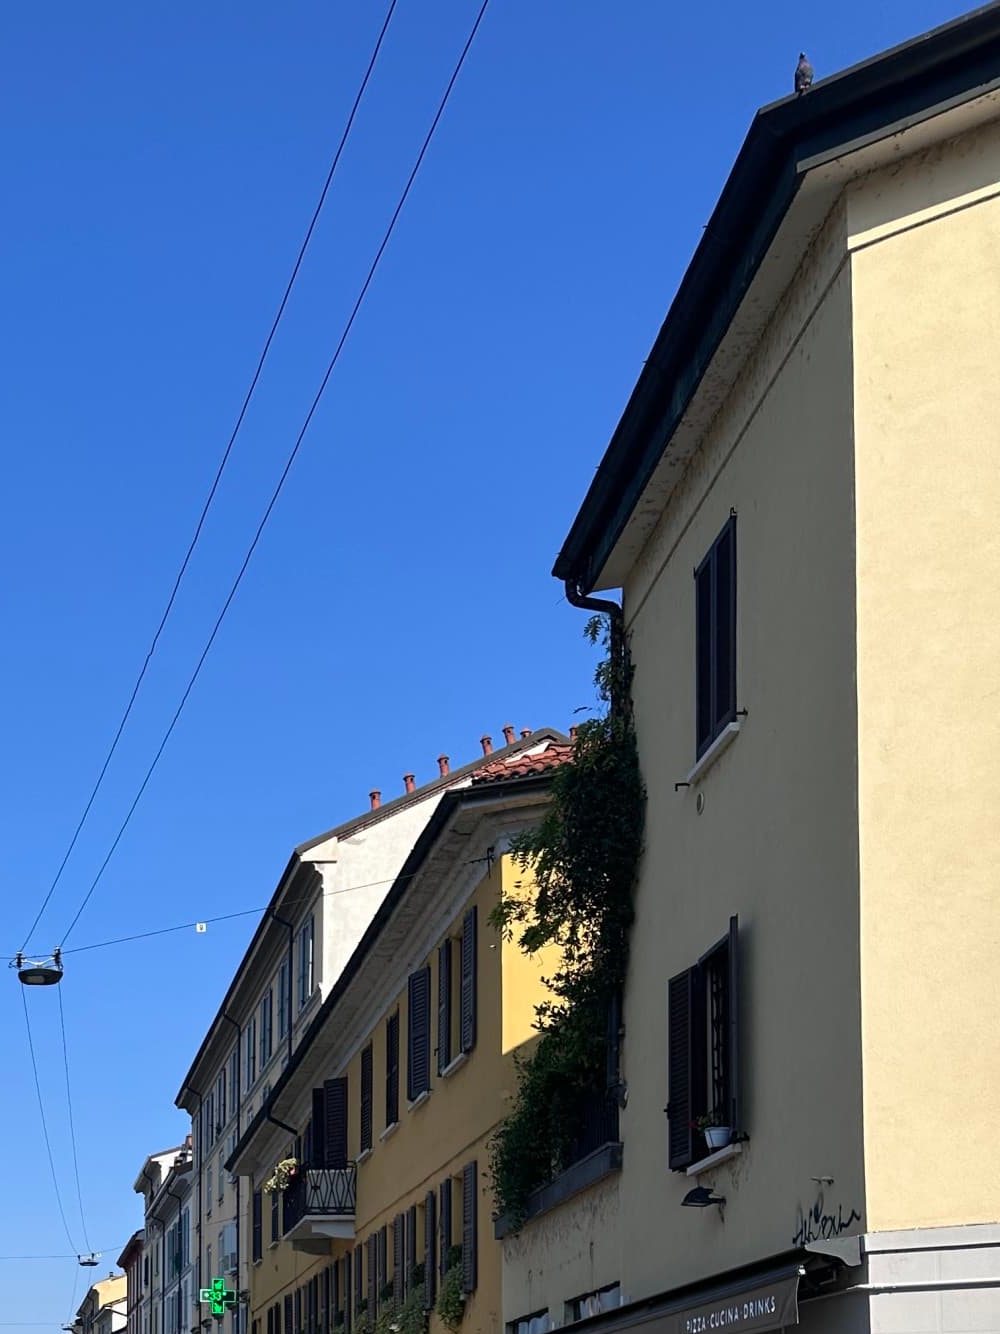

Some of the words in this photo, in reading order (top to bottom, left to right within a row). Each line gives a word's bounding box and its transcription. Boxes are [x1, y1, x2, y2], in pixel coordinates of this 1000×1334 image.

[686, 1317, 707, 1334] PIZZA
[709, 1306, 739, 1329] CUCINA
[743, 1295, 776, 1320] DRINKS
